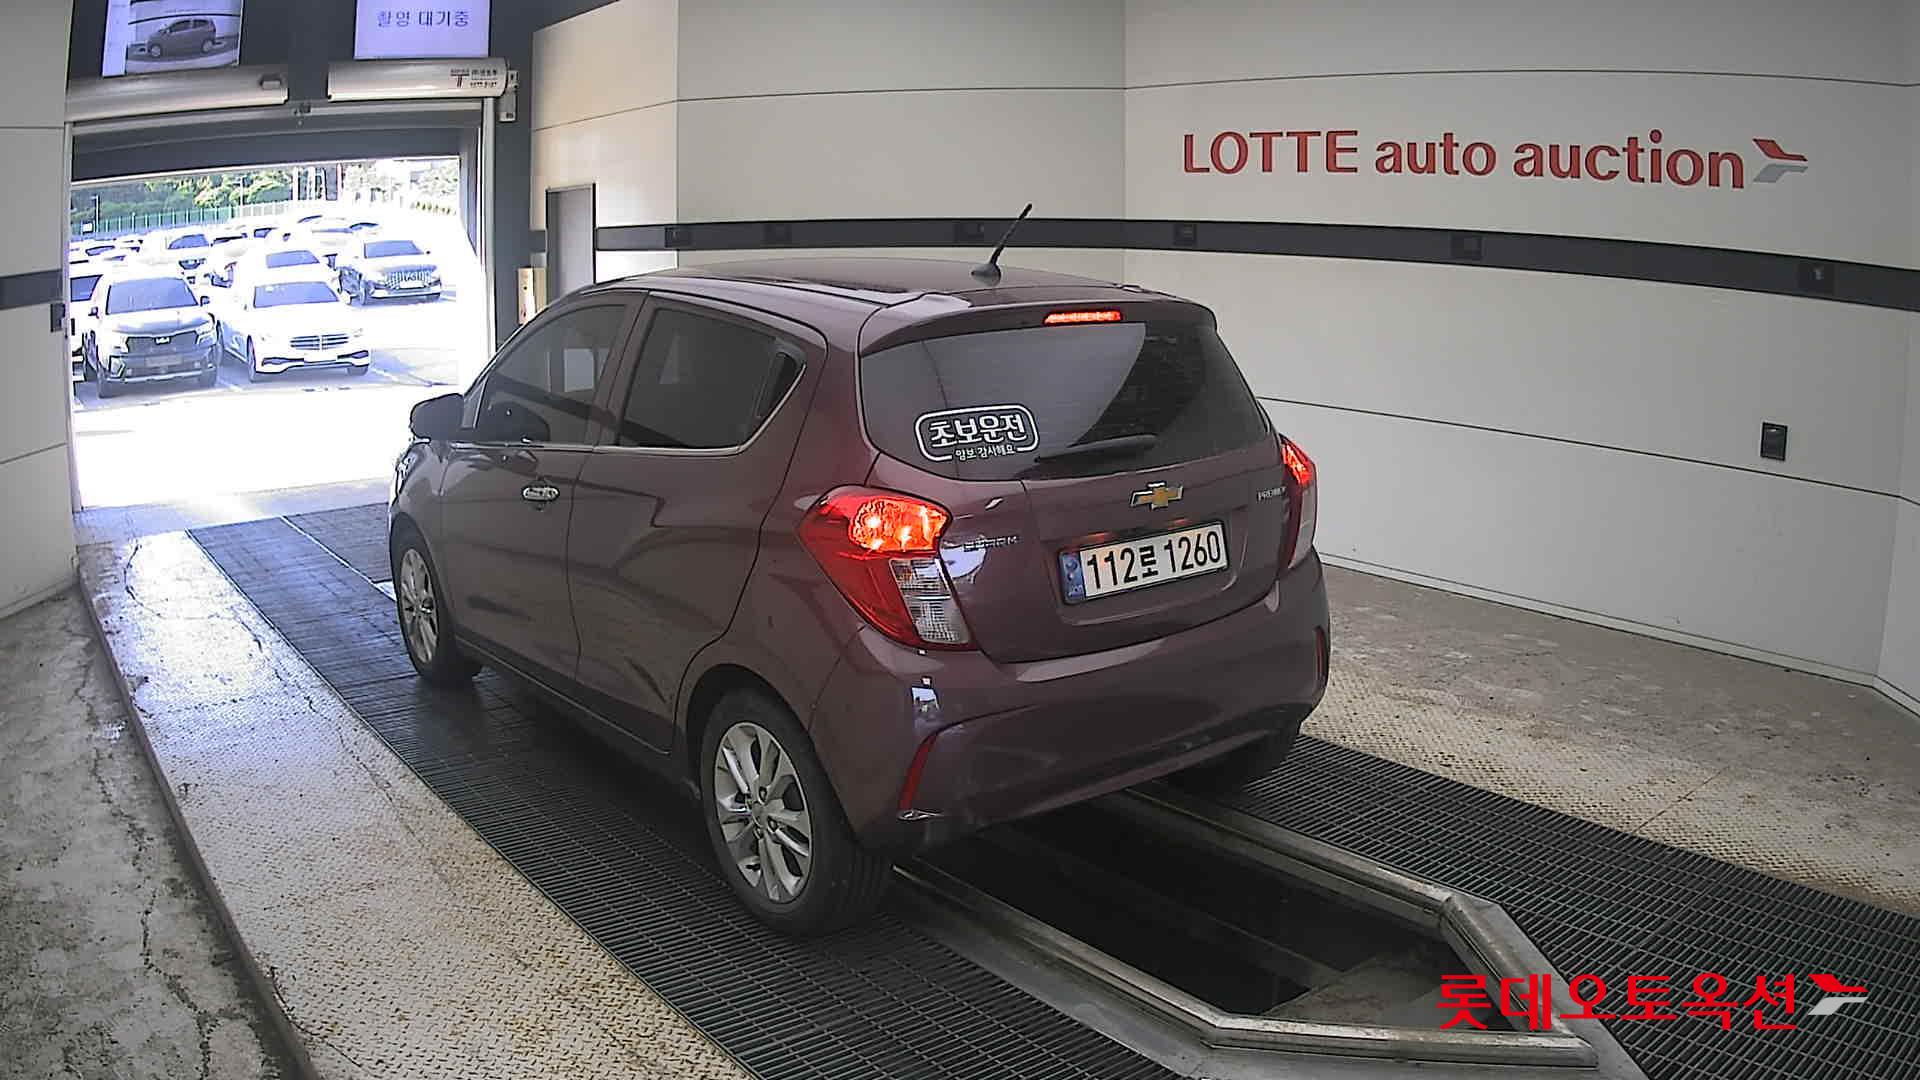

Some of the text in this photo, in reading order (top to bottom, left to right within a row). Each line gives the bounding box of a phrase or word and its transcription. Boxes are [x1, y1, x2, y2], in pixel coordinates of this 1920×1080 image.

[417, 10, 470, 27] 대기중
[1183, 129, 1744, 188] LOTTE auto auction
[930, 414, 1028, 448] 초보운전
[1087, 531, 1221, 590] 112로 1260
